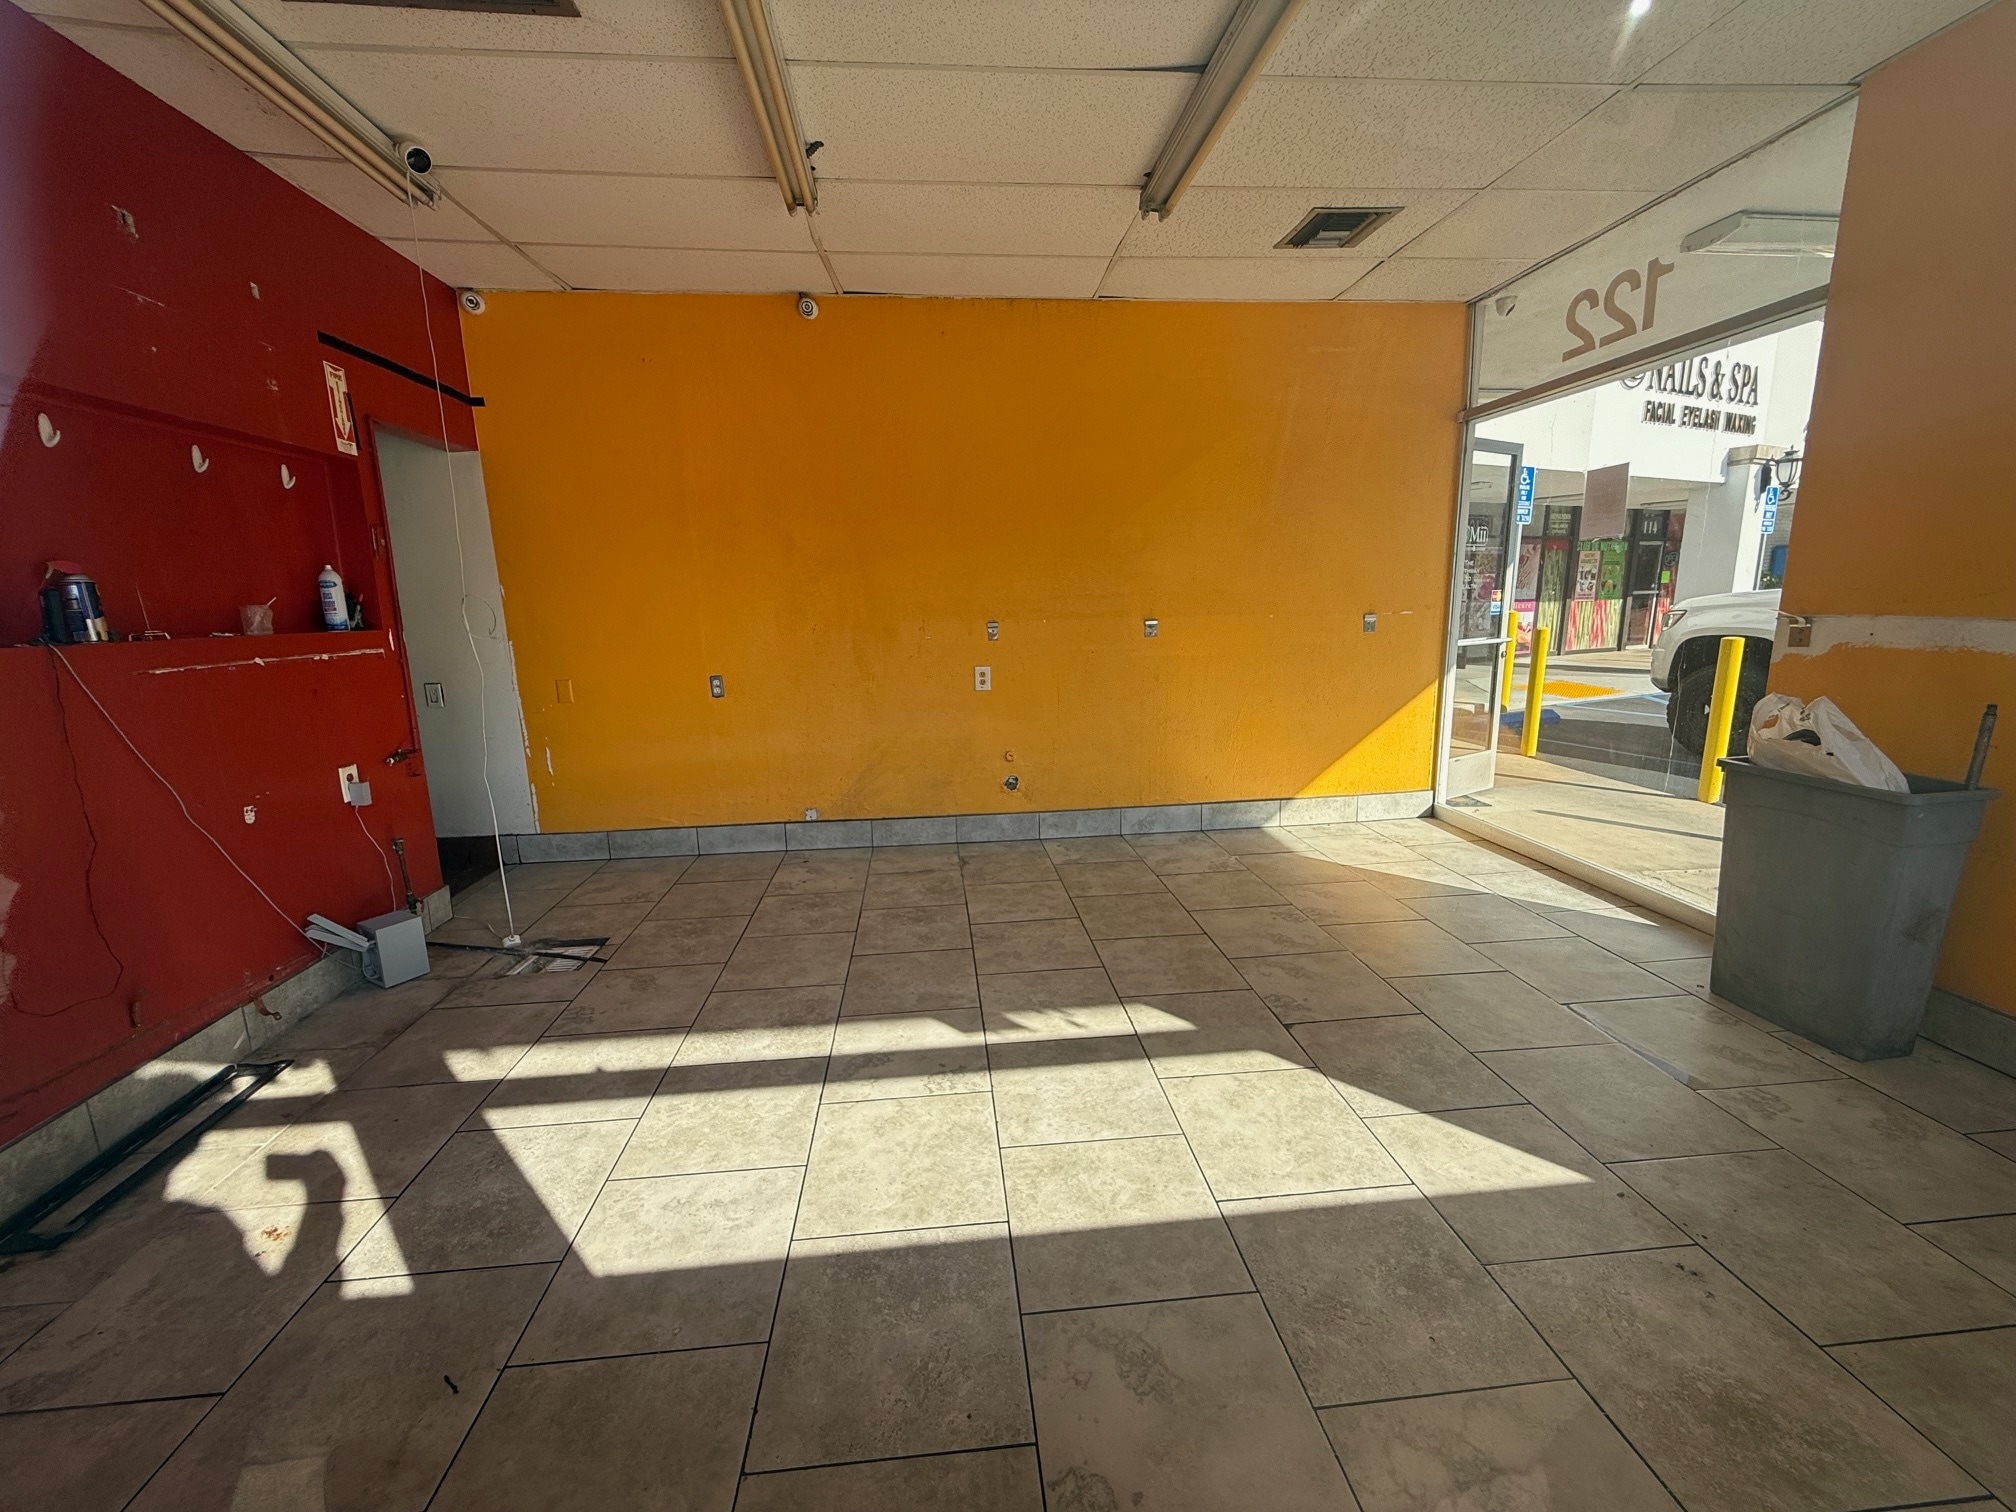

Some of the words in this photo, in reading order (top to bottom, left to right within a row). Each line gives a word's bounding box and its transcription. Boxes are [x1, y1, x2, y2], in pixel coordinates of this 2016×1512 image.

[1645, 356, 1709, 400] NAILS
[1708, 360, 1725, 402] &
[1726, 361, 1759, 407] SPA
[1642, 400, 1676, 425] FACIAL
[1680, 405, 1721, 431] EYELASH
[1723, 412, 1757, 436] WAXING
[1643, 520, 1658, 535] 114
